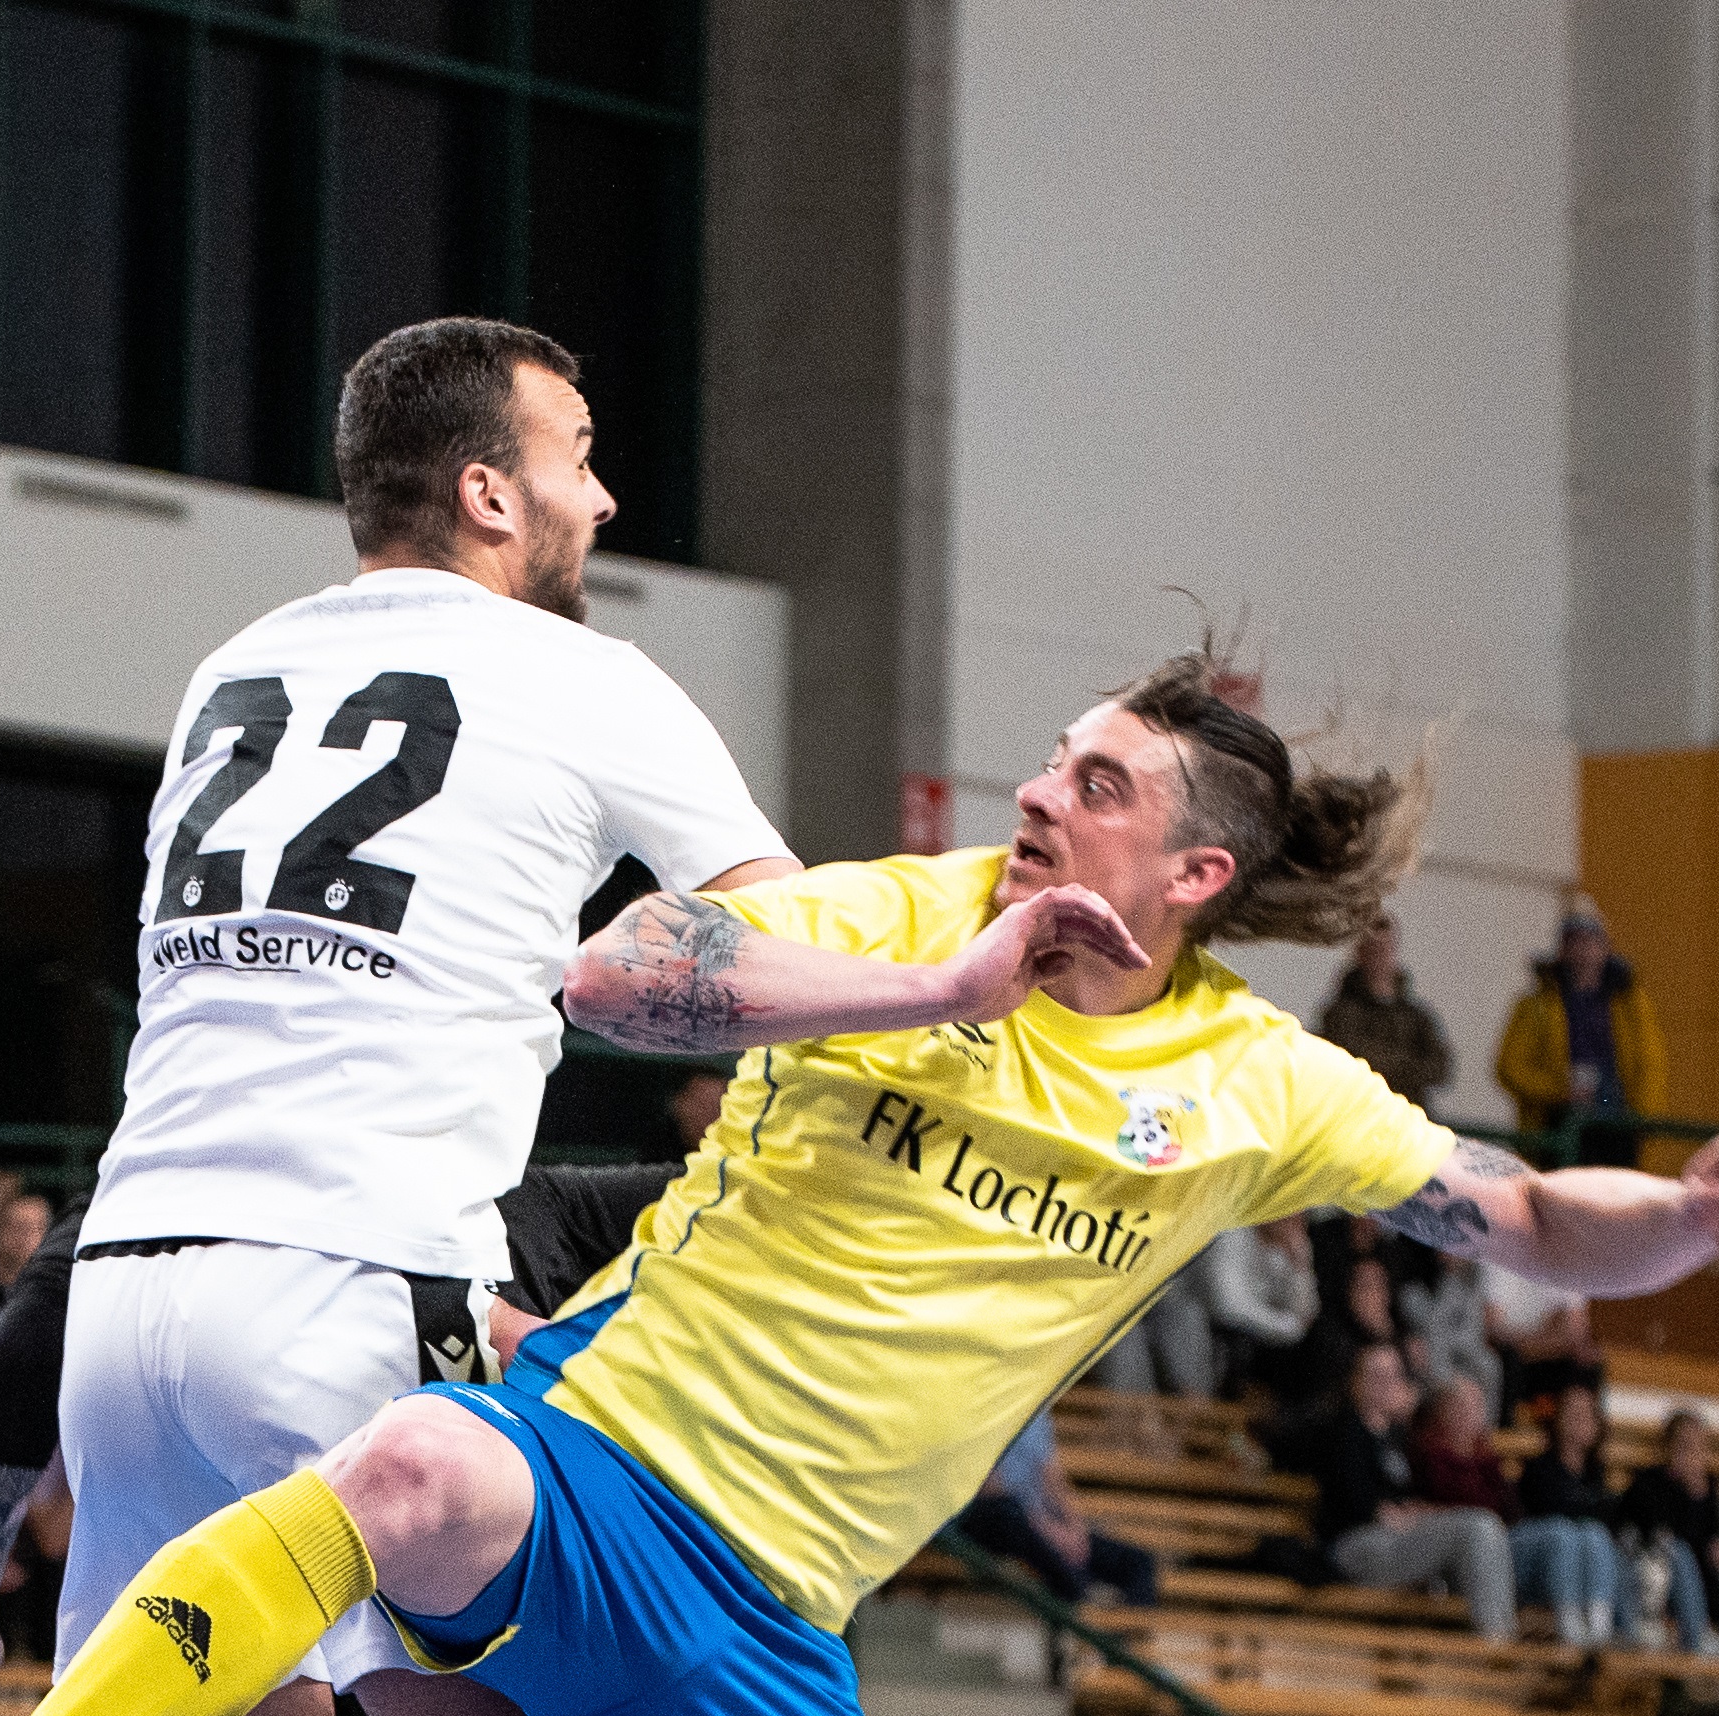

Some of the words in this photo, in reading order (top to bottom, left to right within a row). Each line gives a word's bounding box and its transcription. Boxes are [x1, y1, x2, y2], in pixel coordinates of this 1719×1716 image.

[154, 672, 462, 935] 22
[236, 926, 396, 979] Service
[861, 1090, 942, 1174] FK
[135, 1596, 212, 1685] adidas
